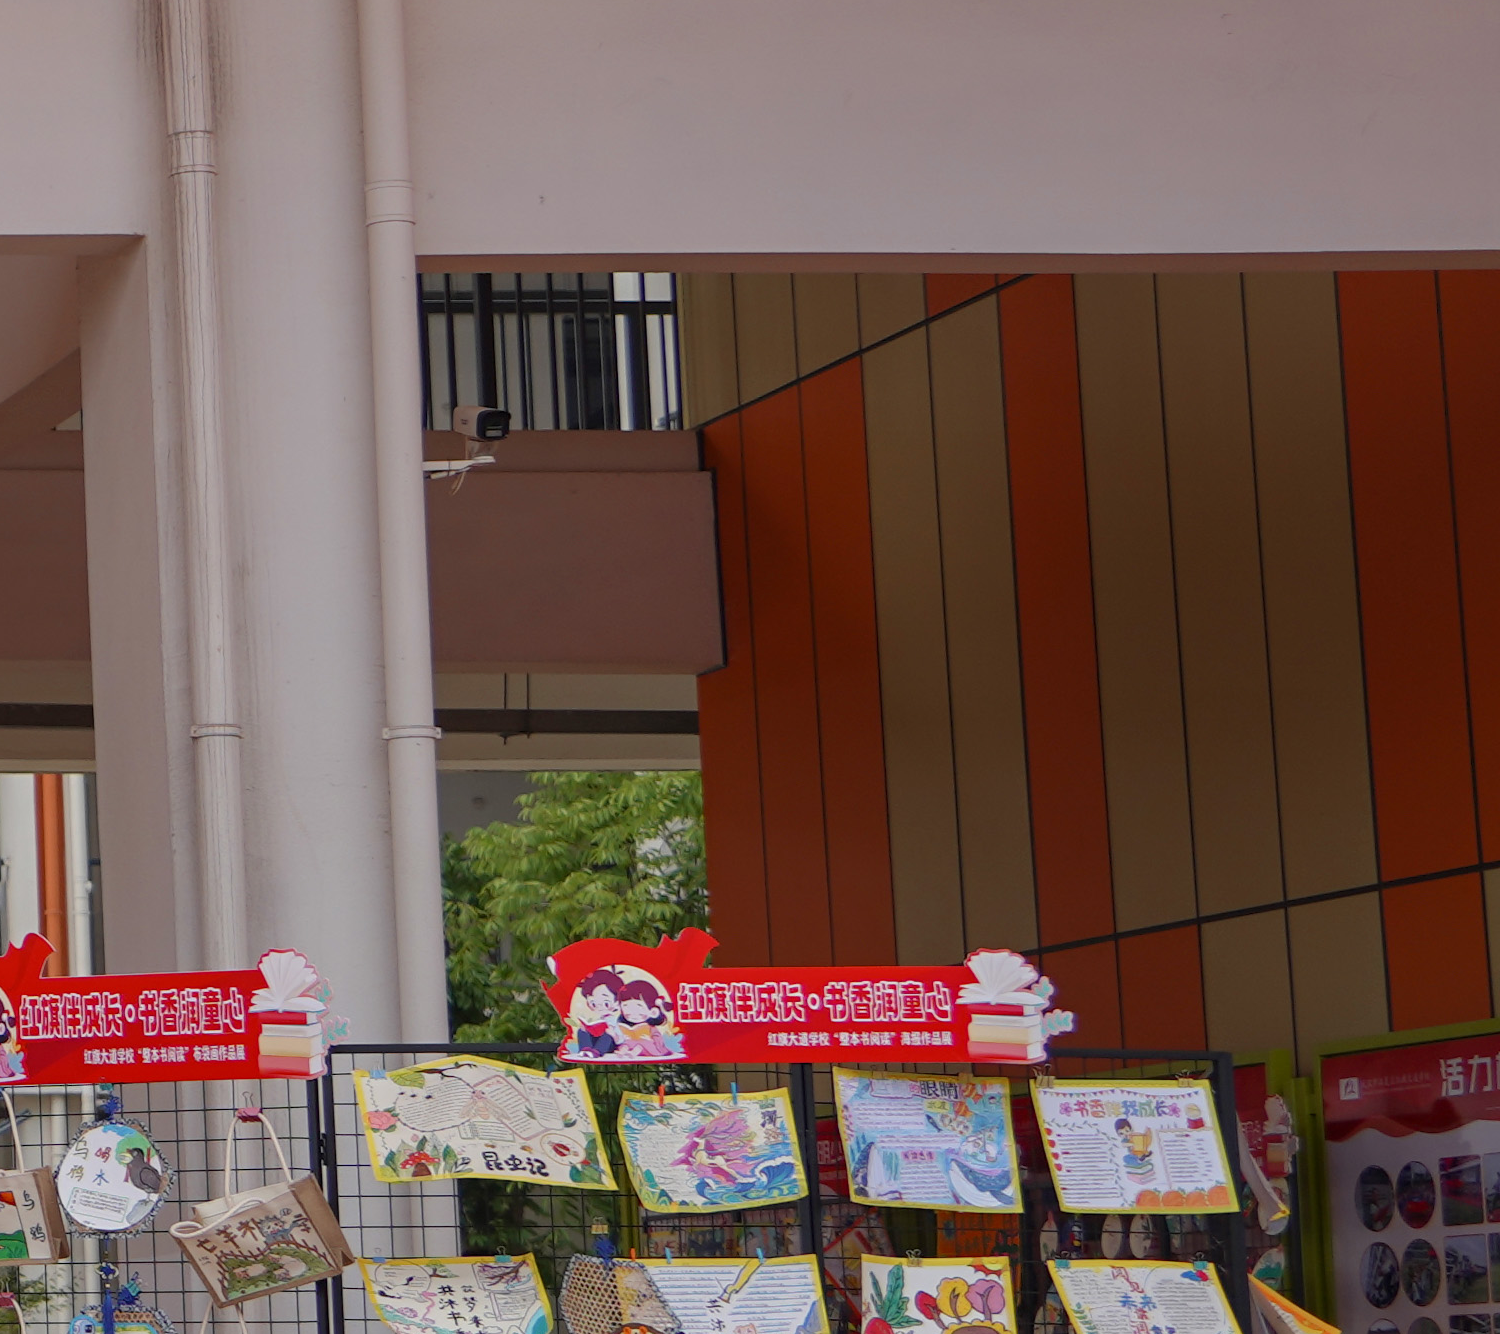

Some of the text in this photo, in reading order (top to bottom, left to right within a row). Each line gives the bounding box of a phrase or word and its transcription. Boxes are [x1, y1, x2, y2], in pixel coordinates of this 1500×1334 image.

[1439, 1053, 1500, 1097] 活力
[481, 1151, 550, 1178] 昆虫记
